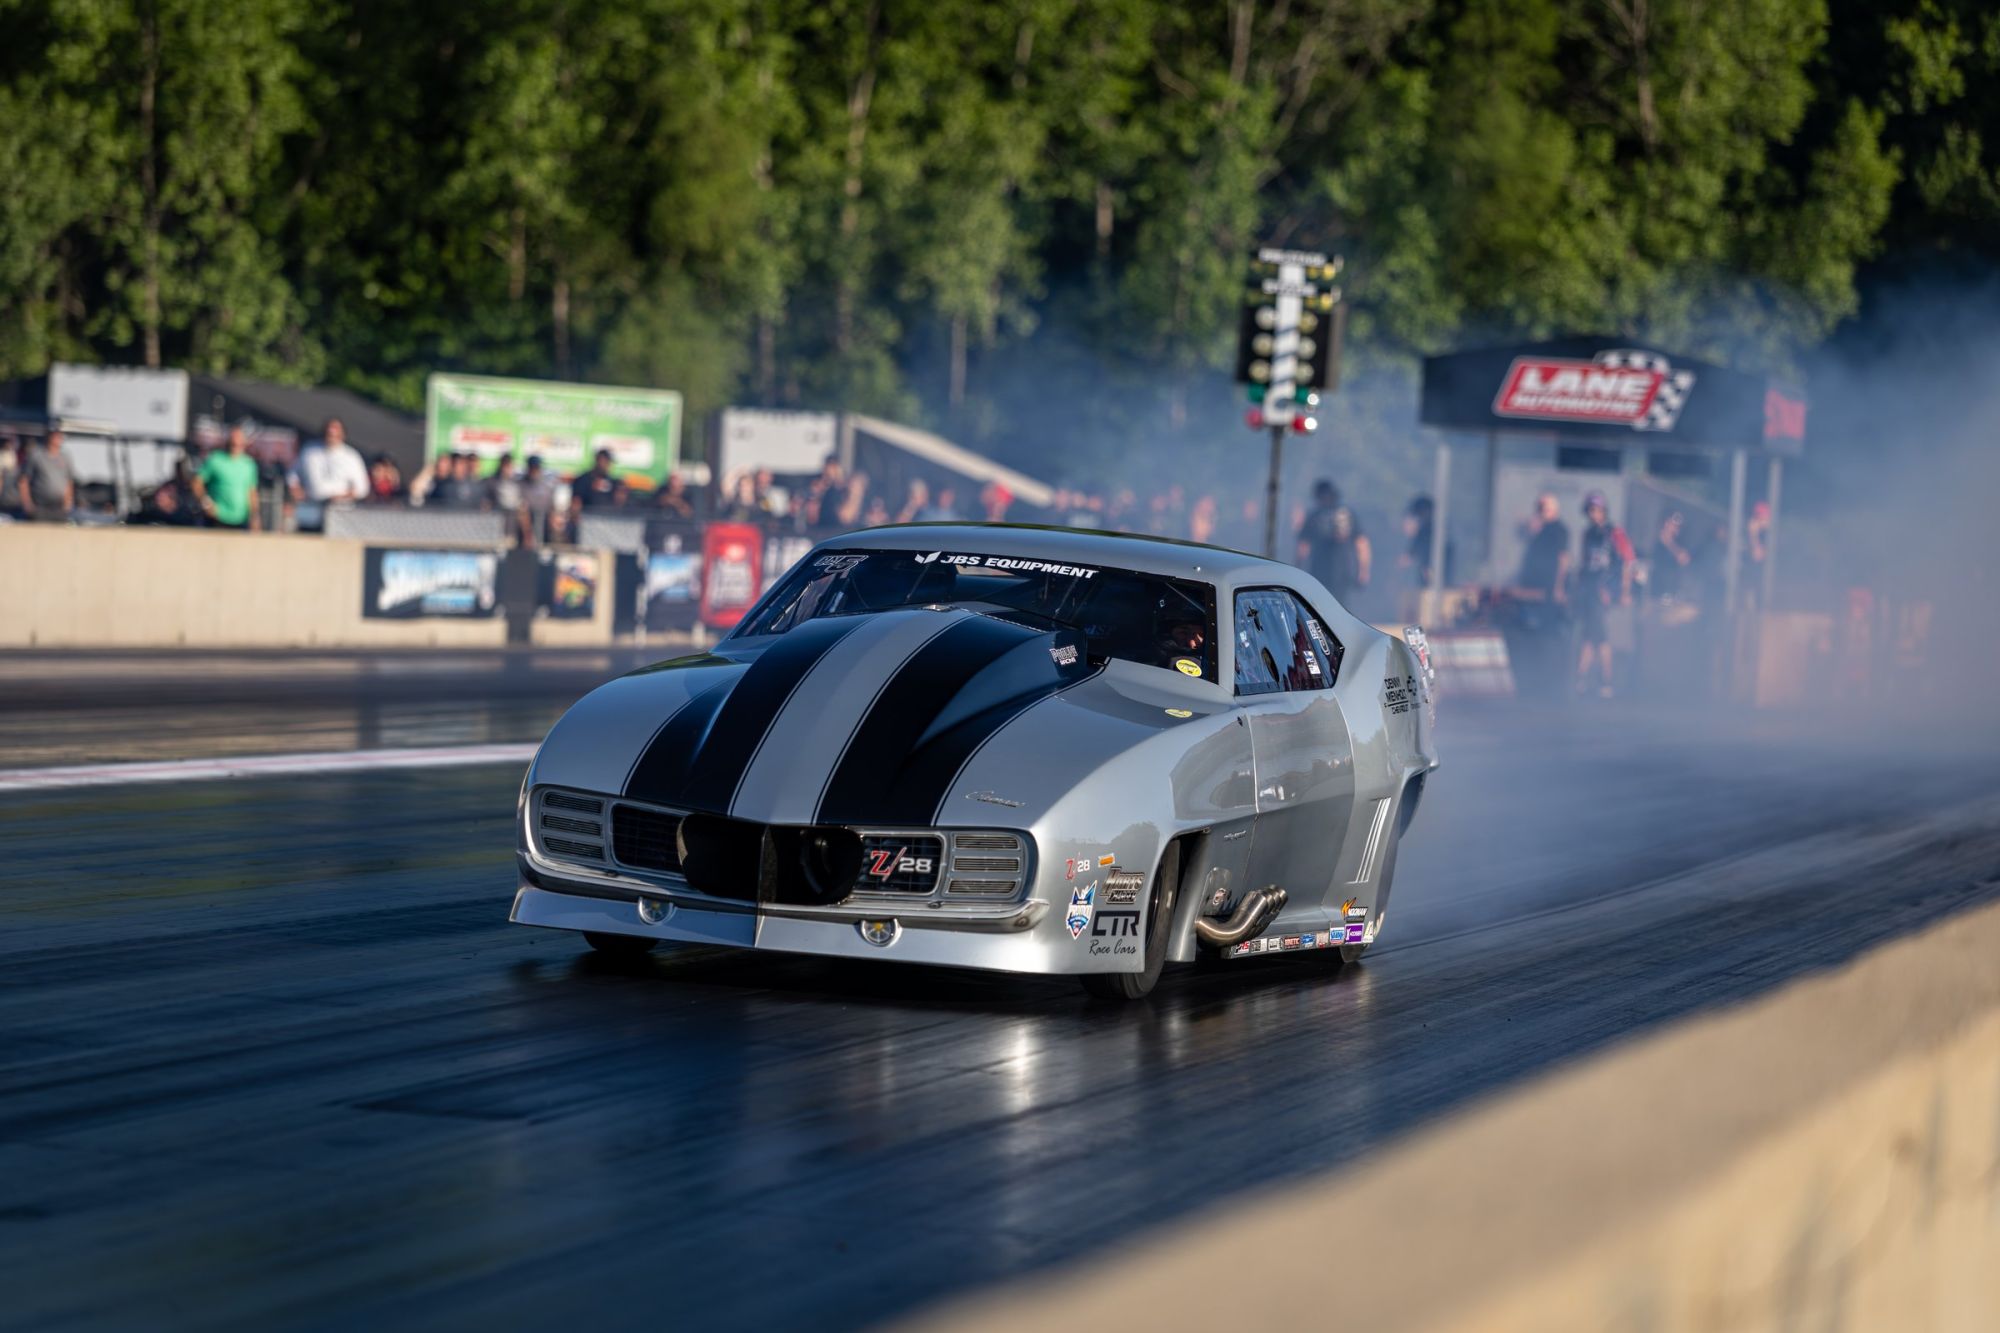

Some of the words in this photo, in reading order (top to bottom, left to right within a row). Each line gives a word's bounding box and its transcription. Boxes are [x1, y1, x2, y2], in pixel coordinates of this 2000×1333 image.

[1517, 367, 1653, 398] LANE
[940, 554, 982, 566] JBS
[984, 557, 1100, 579] EQUIPMENT
[869, 846, 932, 882] Z/28
[1092, 911, 1140, 936] CTR
[1089, 938, 1111, 956] Race
[1113, 938, 1137, 955] Cars
